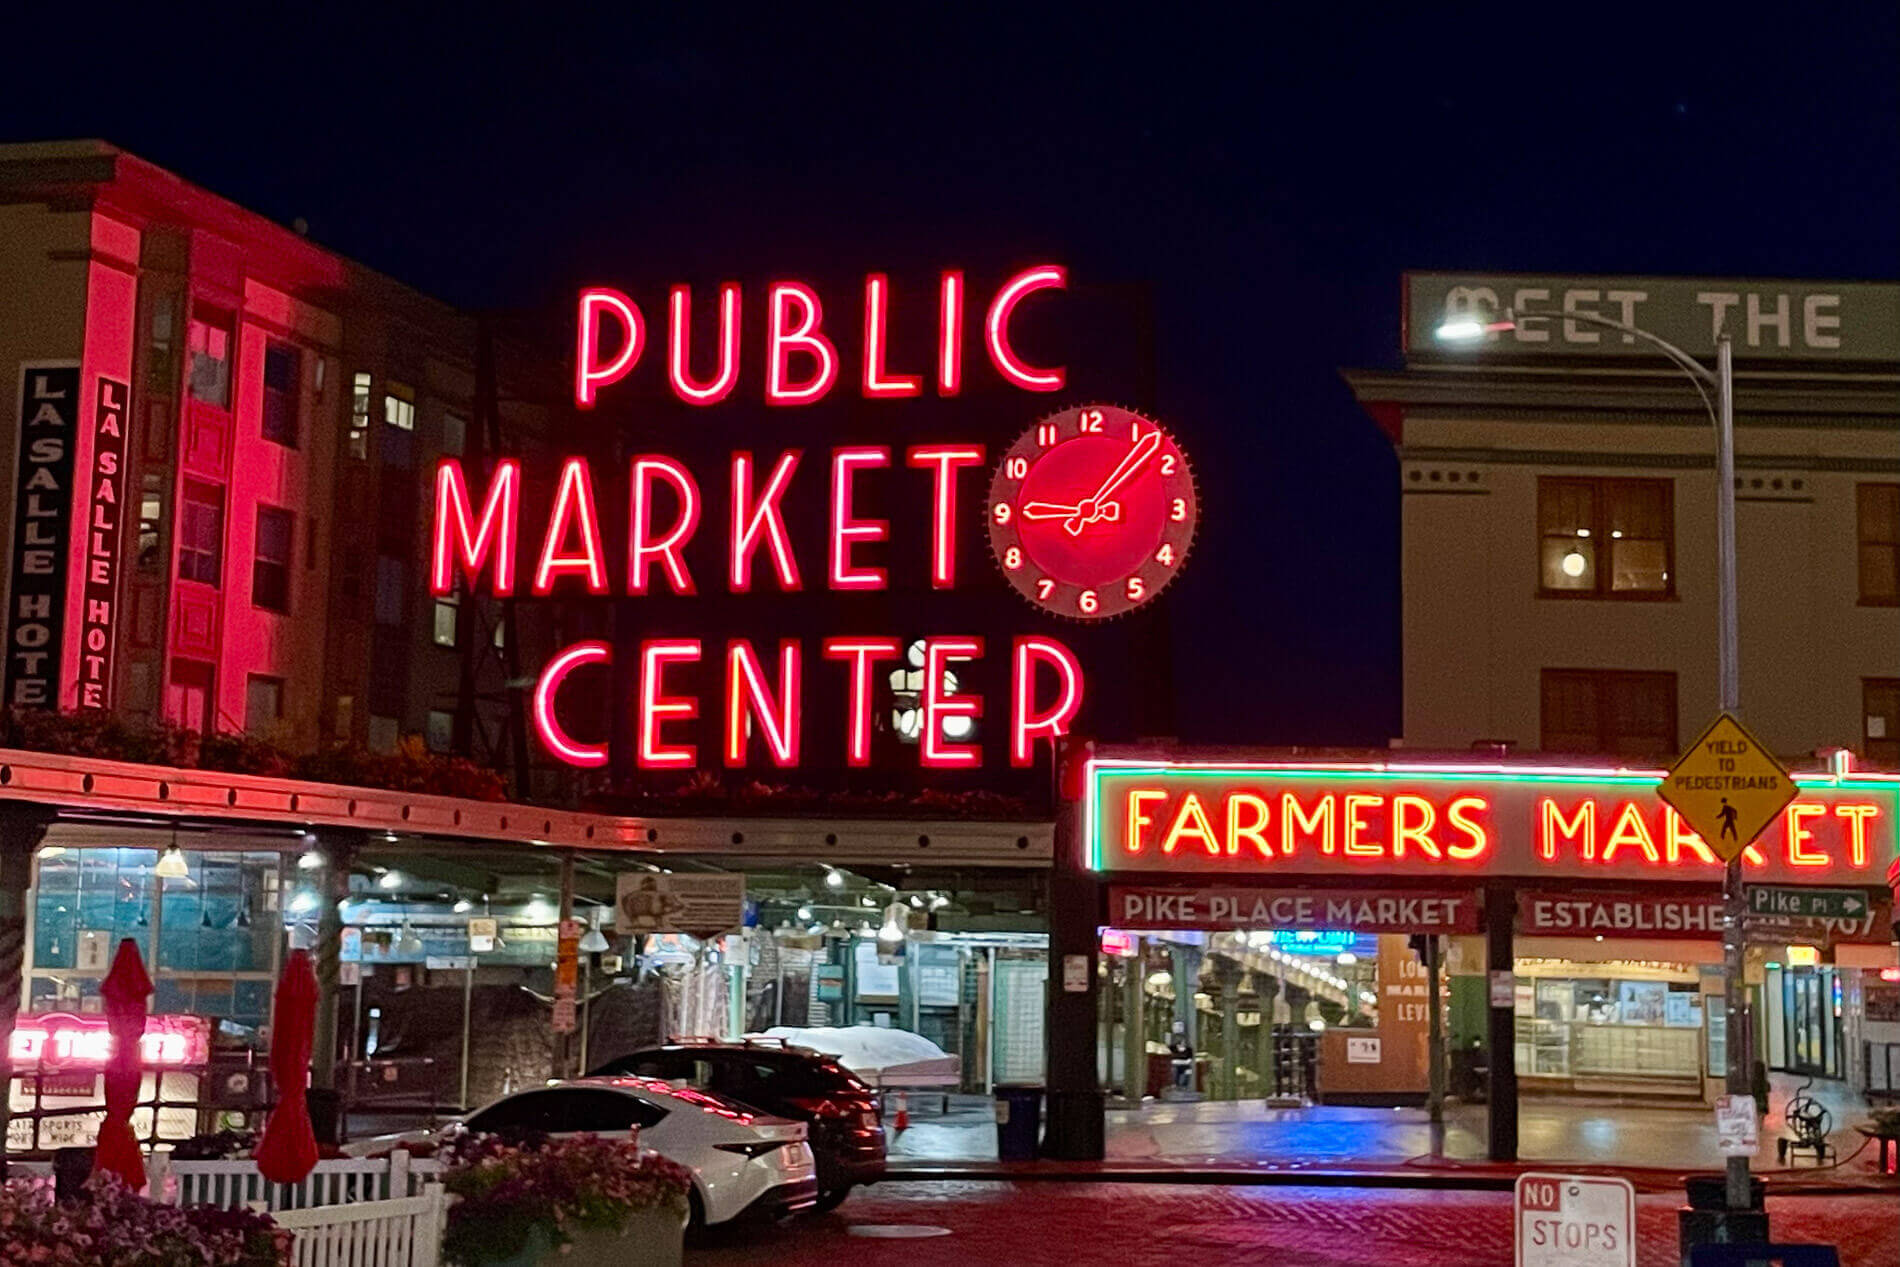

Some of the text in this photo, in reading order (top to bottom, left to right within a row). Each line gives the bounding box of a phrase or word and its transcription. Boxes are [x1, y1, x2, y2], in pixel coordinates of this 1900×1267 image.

[1445, 285, 1841, 348] MEET THE
[576, 264, 1069, 410] PUBLIC
[1080, 411, 1103, 432] 12
[1039, 426, 1056, 446] 11
[1006, 458, 1027, 479] 10
[1161, 455, 1175, 474] 2
[429, 445, 986, 597] MARKET
[994, 503, 1011, 524] 9
[1171, 499, 1186, 521] 3
[14, 375, 65, 706] LA SALLE HOTE
[83, 383, 121, 708] LA SALLE HOTE
[1005, 548, 1021, 569] 8
[1156, 544, 1174, 565] 4
[1038, 580, 1052, 599] 7
[1128, 578, 1143, 599] 5
[1080, 591, 1098, 613] 6
[533, 635, 1085, 769] CENTER
[1706, 741, 1748, 754] YIELD
[1718, 758, 1736, 772] TO
[1675, 776, 1778, 790] PEDESTRIANS
[1126, 790, 1881, 868] FARMERS MARET
[1124, 895, 1463, 926] PIKE PLACE MARKET
[1755, 889, 1800, 912] Pike
[1535, 900, 1723, 930] ESTABLISHE
[1524, 1182, 1555, 1207] NO
[1532, 1220, 1617, 1250] STOPS
